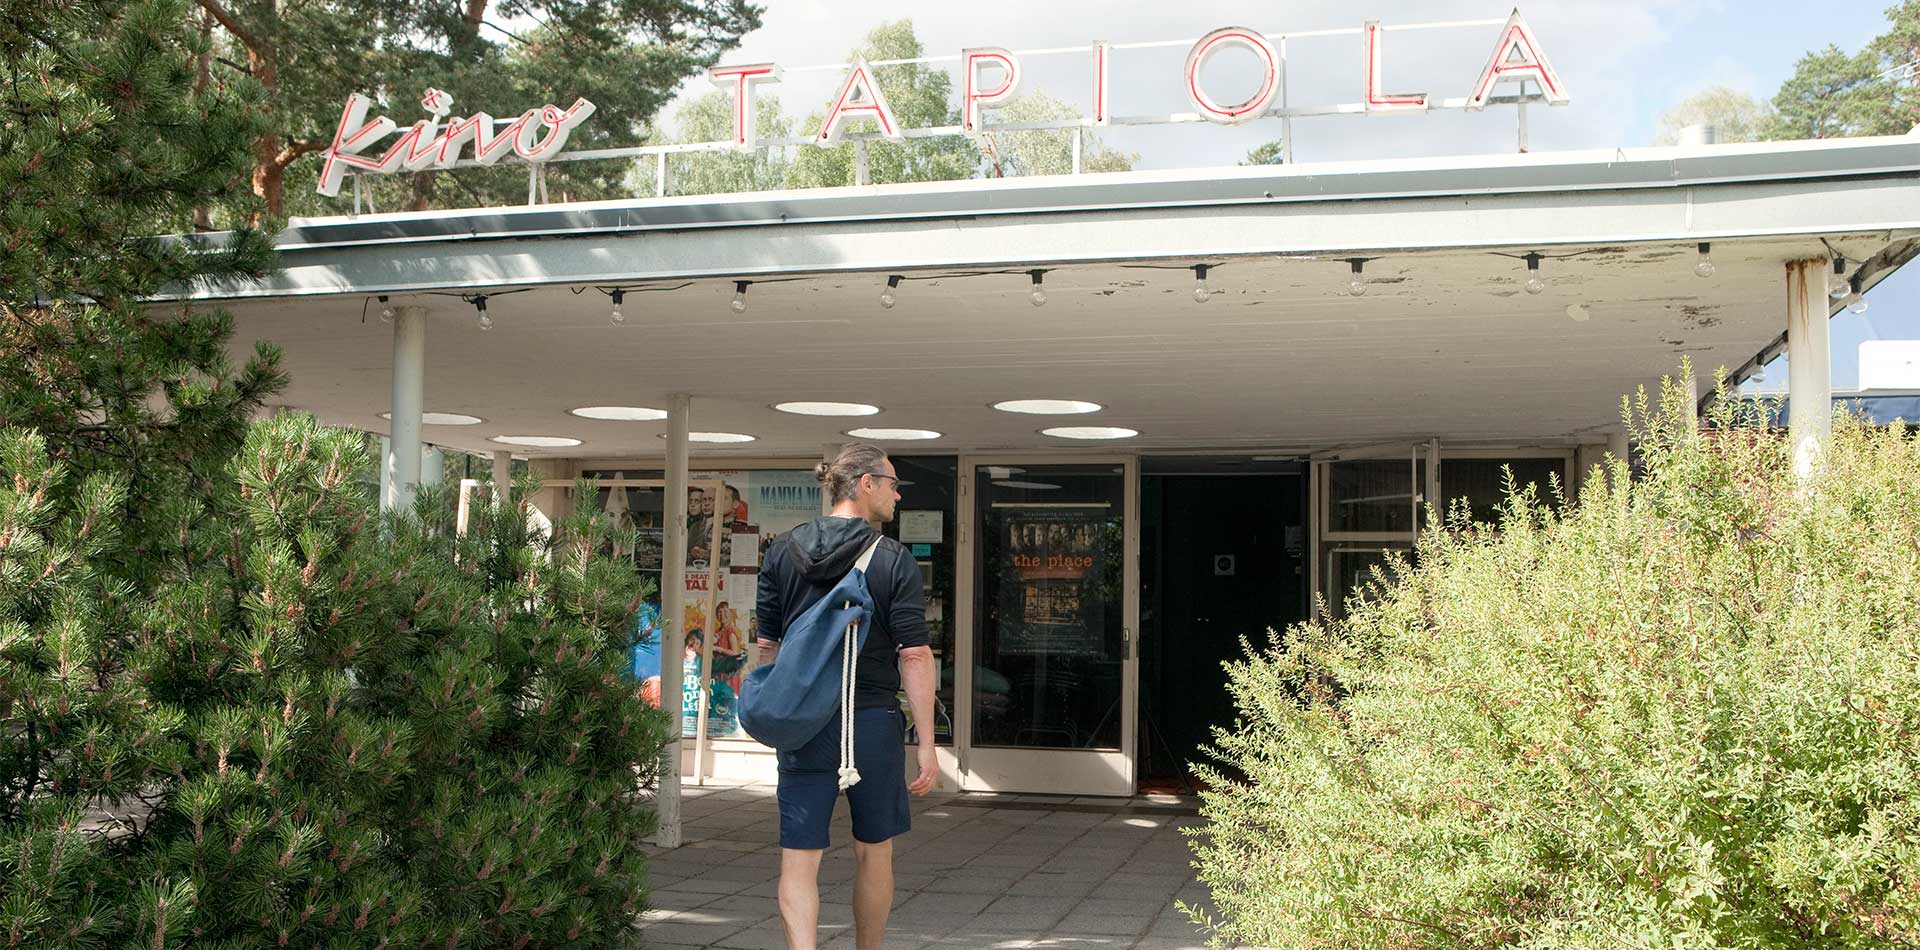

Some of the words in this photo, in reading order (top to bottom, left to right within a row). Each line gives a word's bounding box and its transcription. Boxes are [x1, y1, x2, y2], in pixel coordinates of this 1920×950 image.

[316, 87, 597, 197] kino
[708, 6, 1570, 153] TAPIOLA
[760, 486, 803, 504] MAMMA
[1014, 554, 1041, 568] the
[1047, 554, 1094, 571] place
